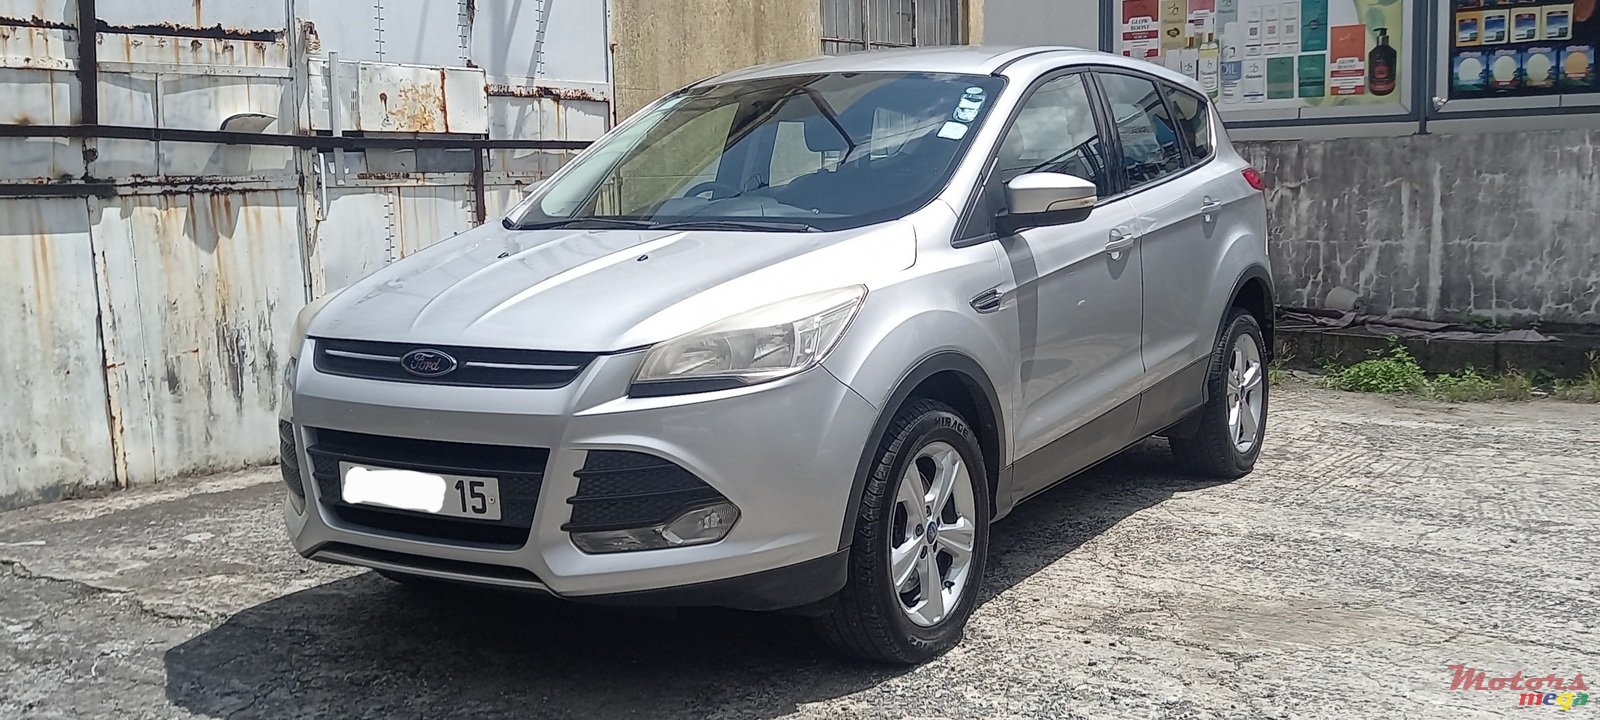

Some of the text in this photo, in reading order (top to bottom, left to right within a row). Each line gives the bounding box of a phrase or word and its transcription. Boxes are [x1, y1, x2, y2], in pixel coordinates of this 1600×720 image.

[1220, 63, 1238, 75] OIL
[410, 352, 441, 372] Ford
[935, 416, 969, 439] MIRAGE
[455, 480, 487, 515] 15
